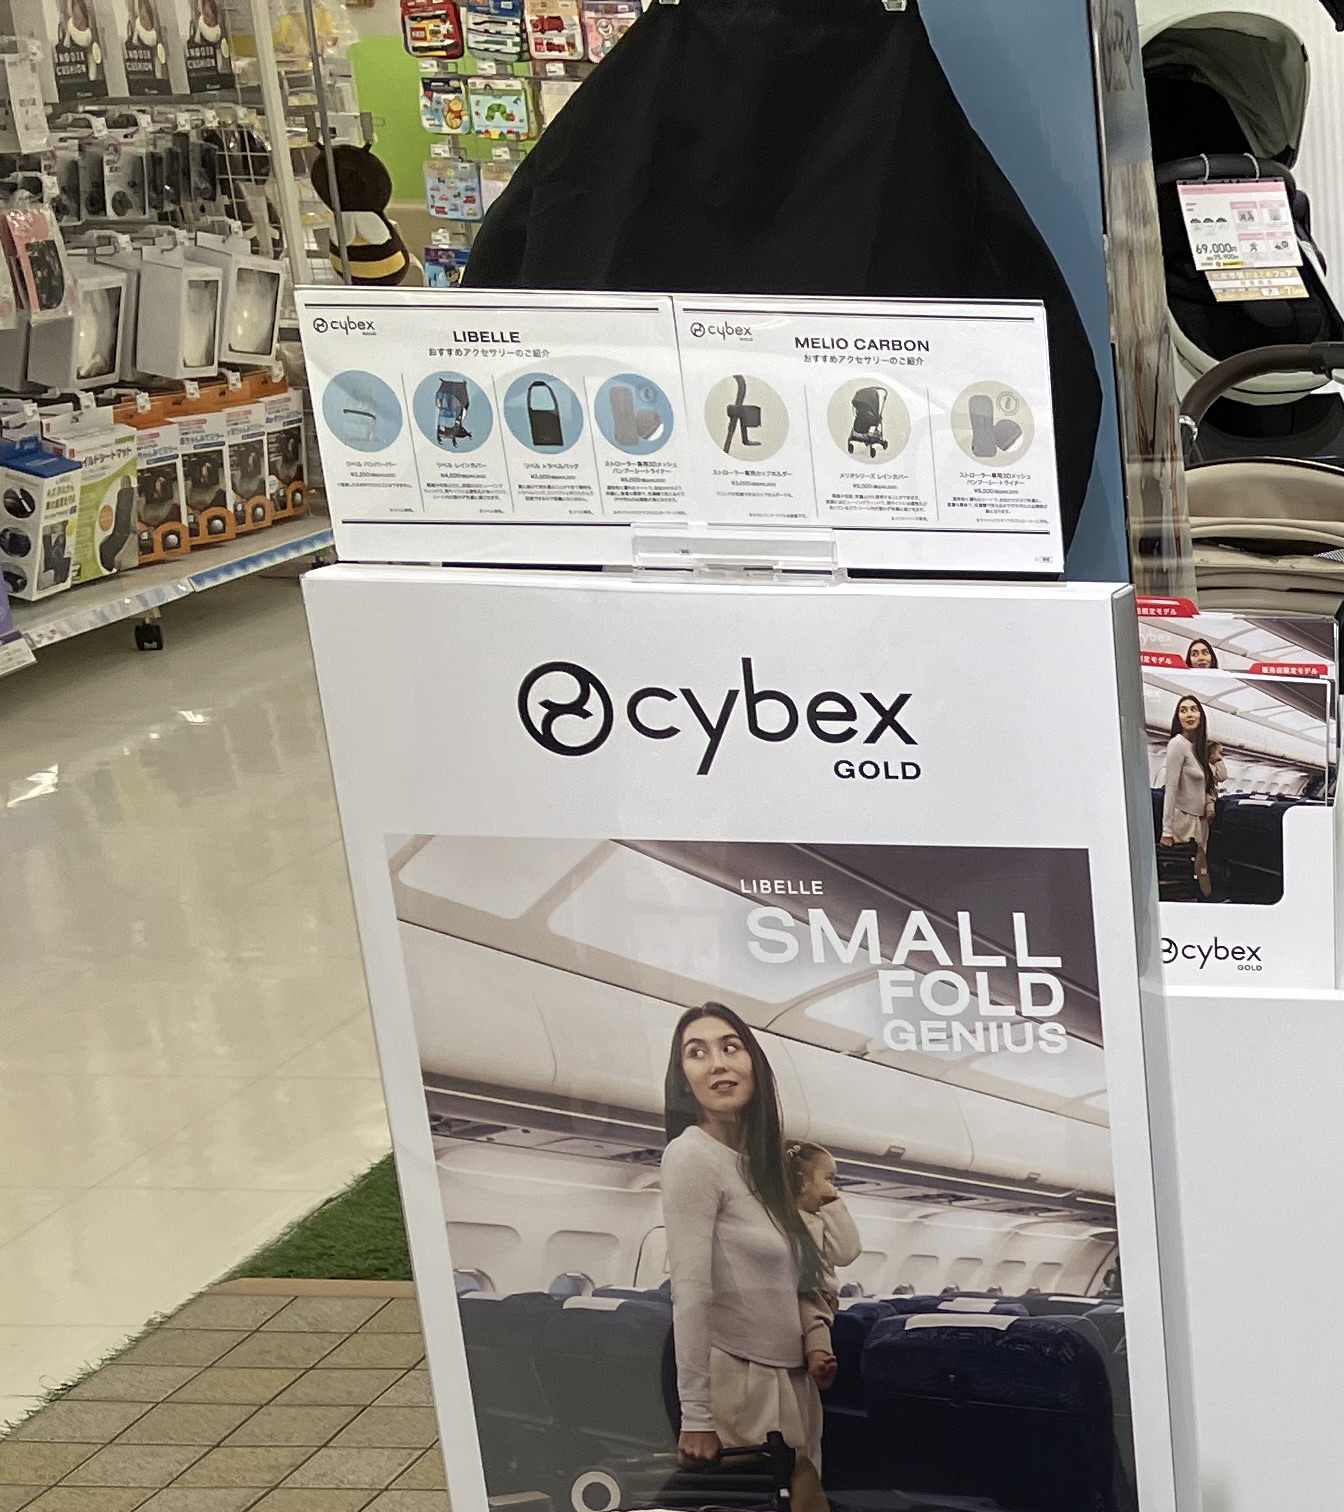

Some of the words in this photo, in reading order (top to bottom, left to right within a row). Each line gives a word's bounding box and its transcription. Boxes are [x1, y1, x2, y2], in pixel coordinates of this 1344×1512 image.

[330, 316, 376, 335] cybex
[708, 321, 753, 341] cybex
[453, 330, 521, 344] LIBELLE
[794, 337, 849, 350] MELIO
[853, 338, 930, 352] CARBON
[626, 656, 919, 776] cybex
[833, 759, 922, 780] GOLD
[740, 879, 824, 895] LIBELLE
[746, 905, 1063, 968] SMALL
[1181, 937, 1263, 970] cybex
[1237, 963, 1263, 972] GOLD
[878, 969, 1066, 1018] FOLD
[883, 1019, 1068, 1054] GENIUS
